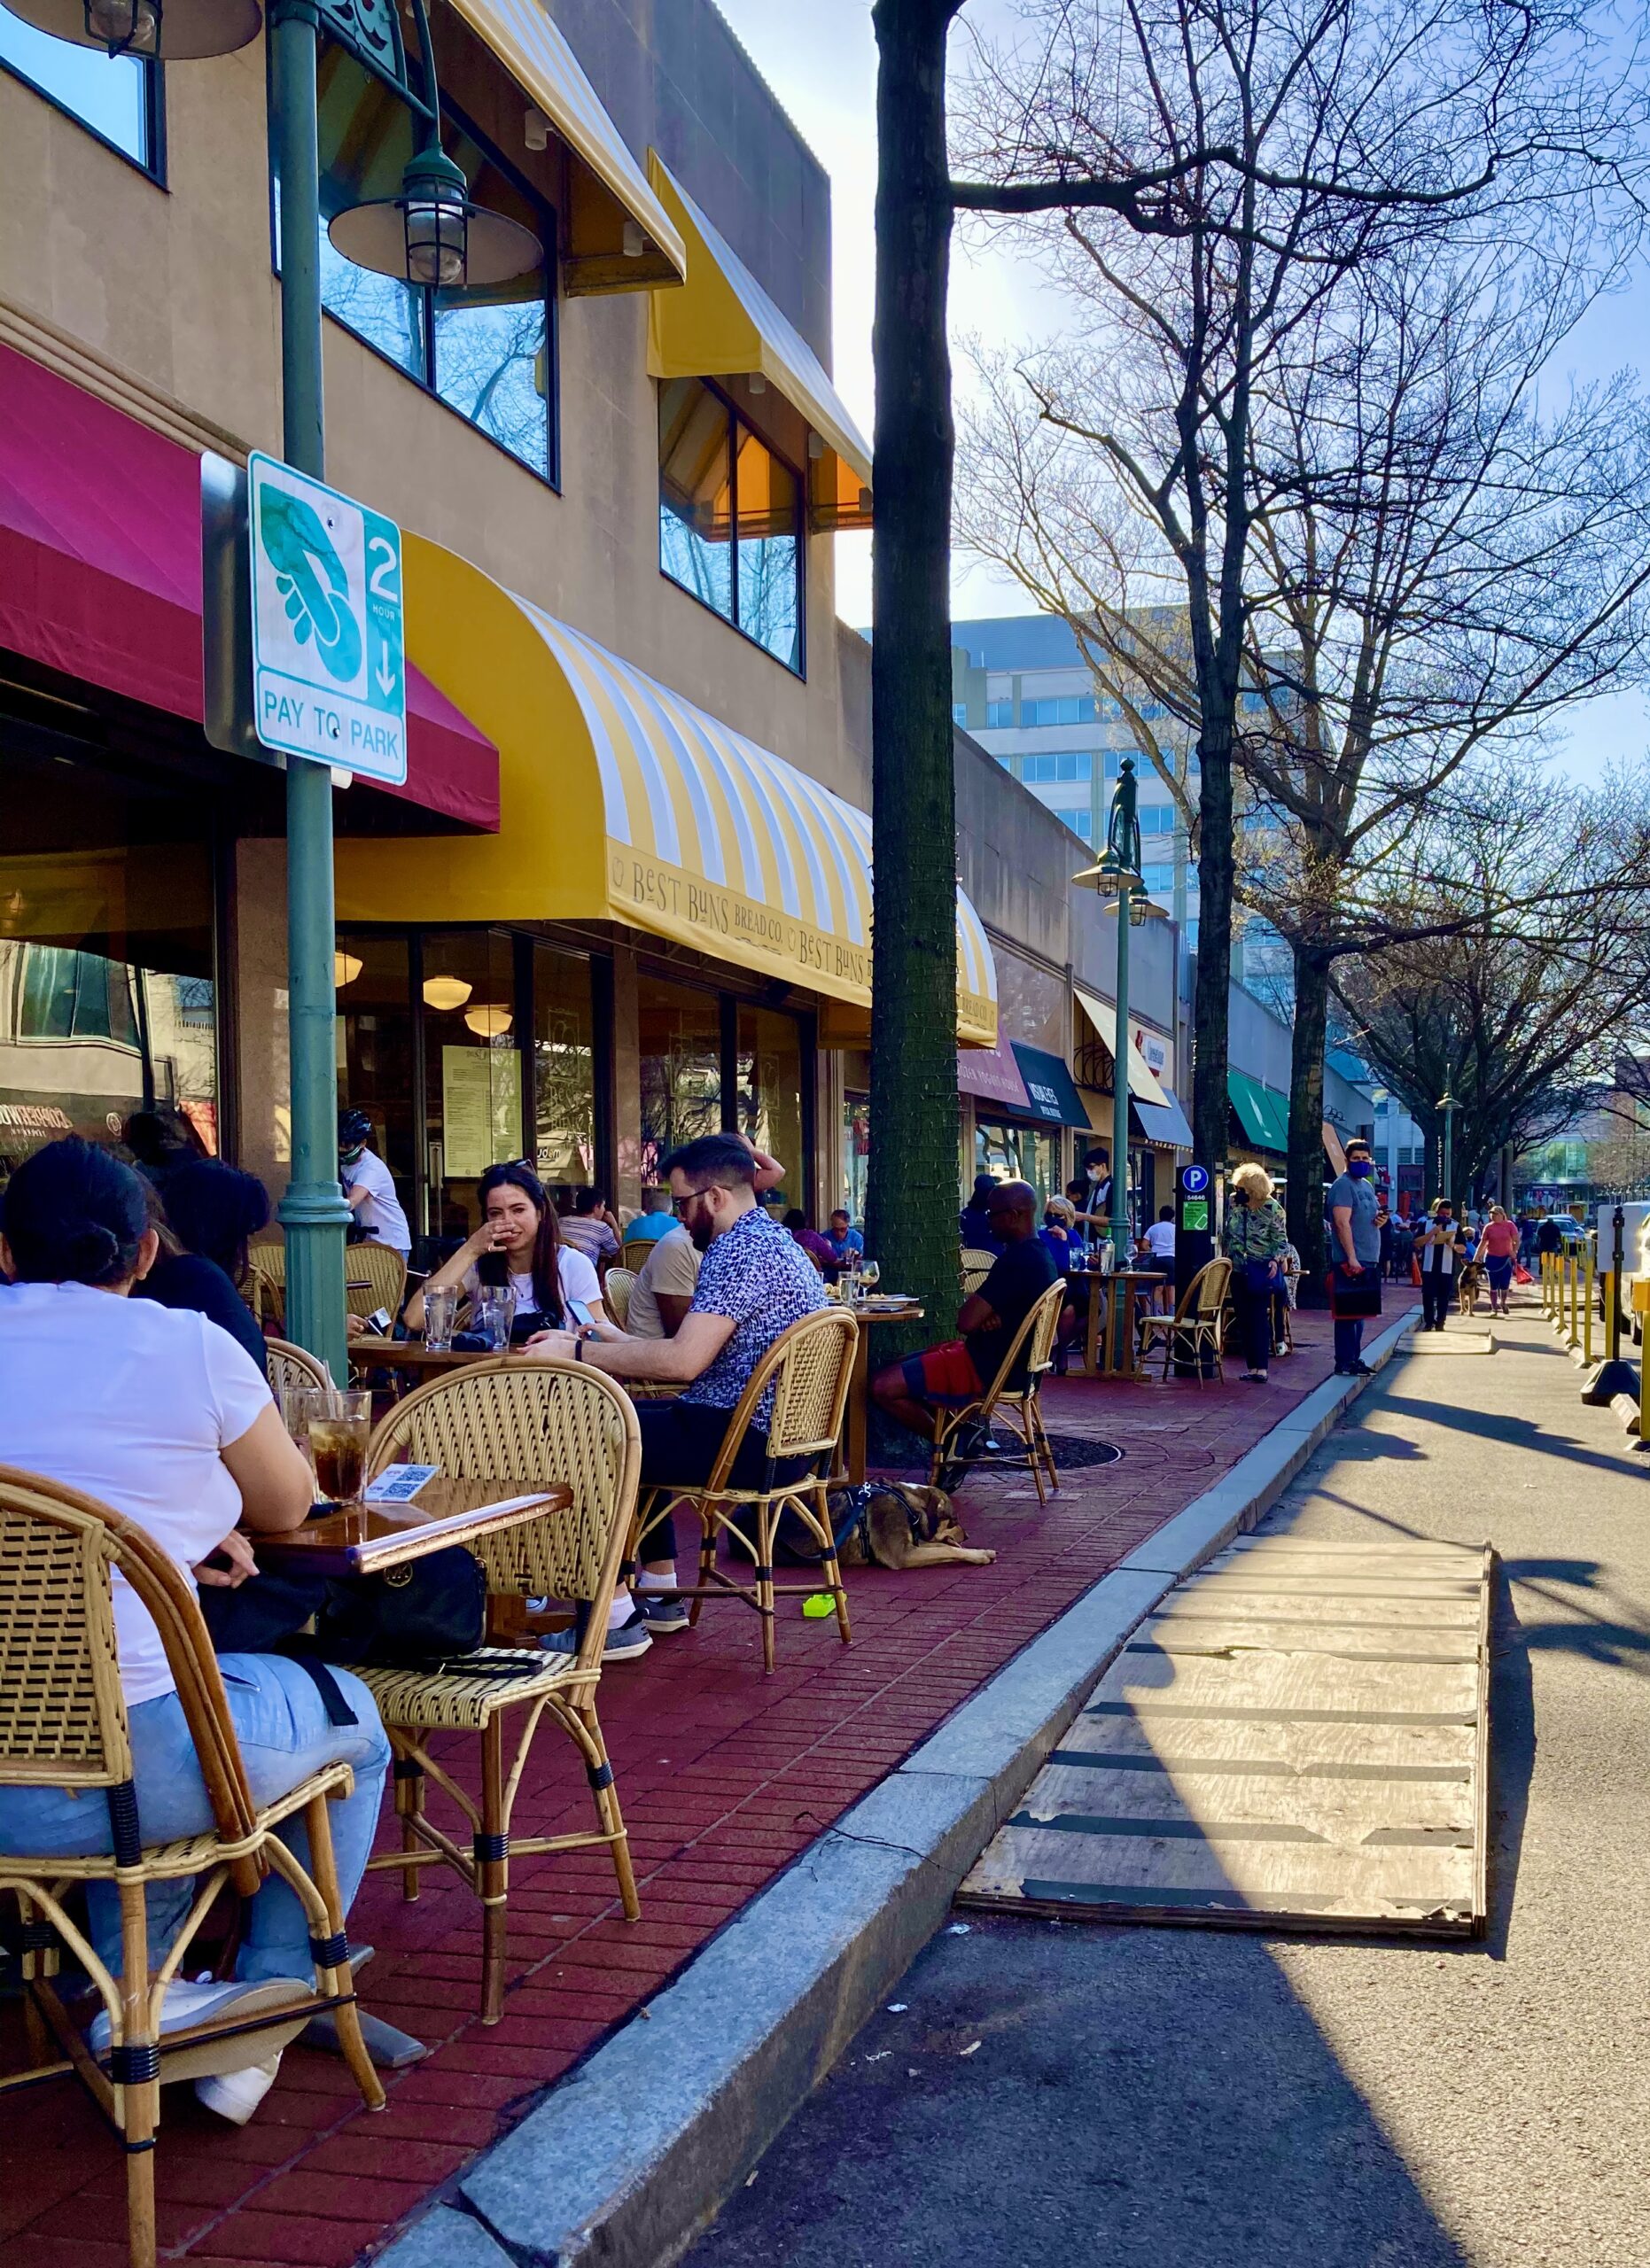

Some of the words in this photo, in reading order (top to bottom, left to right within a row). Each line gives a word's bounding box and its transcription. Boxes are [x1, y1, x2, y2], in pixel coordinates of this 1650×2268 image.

[369, 536, 398, 602] 2
[372, 603, 395, 620] HOUR
[264, 690, 304, 728] PAY
[314, 707, 340, 740] TO
[351, 718, 399, 759] PARK
[735, 904, 767, 936] BREAD
[767, 919, 783, 943] CO.
[1190, 1169, 1202, 1188] P
